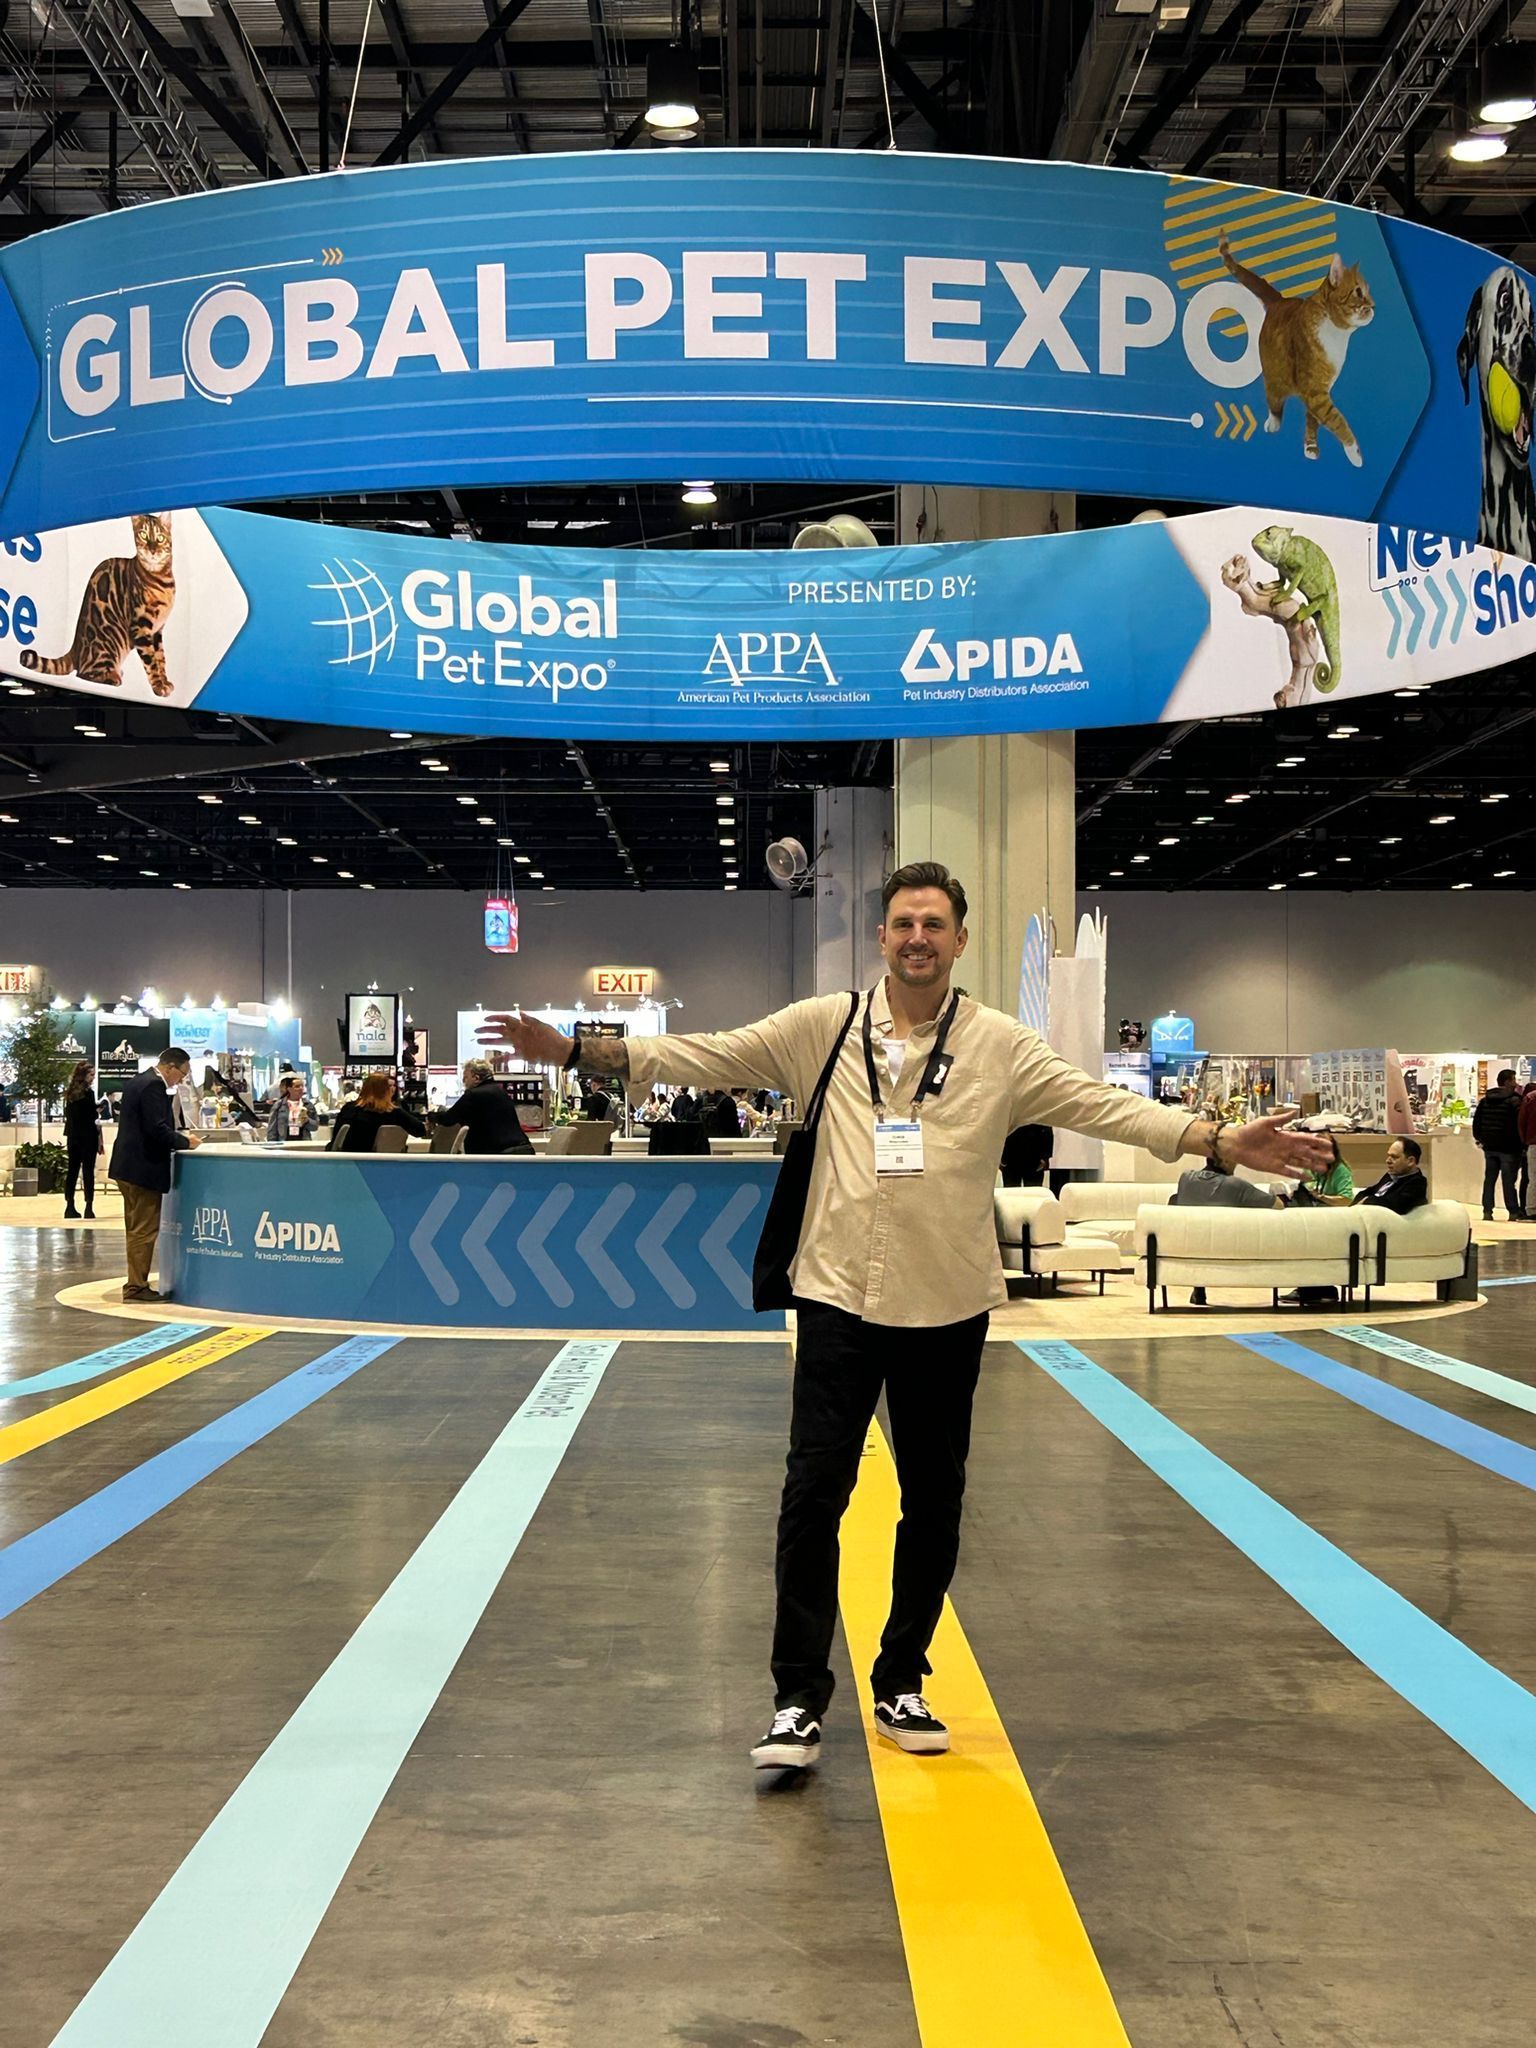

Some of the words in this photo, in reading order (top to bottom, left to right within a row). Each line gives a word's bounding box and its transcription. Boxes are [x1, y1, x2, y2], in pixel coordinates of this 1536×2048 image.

[59, 263, 555, 417] GLOBAL
[584, 251, 867, 361] PET
[903, 256, 1265, 389] EXPO
[401, 569, 618, 639] Global
[788, 578, 934, 604] PRESENTED
[941, 575, 977, 600] BY:
[416, 634, 486, 686] Pet
[701, 632, 840, 687] APPA
[956, 633, 1084, 682] PIDA
[677, 691, 730, 703] American
[732, 691, 750, 703] Pet
[753, 691, 803, 703] Products
[805, 691, 870, 703] Association
[903, 689, 921, 701] Pet
[923, 687, 965, 702] Industry
[968, 685, 1029, 699] Distributors
[1030, 679, 1090, 695] Association
[598, 973, 649, 993] EXIT
[191, 1207, 233, 1247] APPA
[277, 1221, 342, 1252] PIDA
